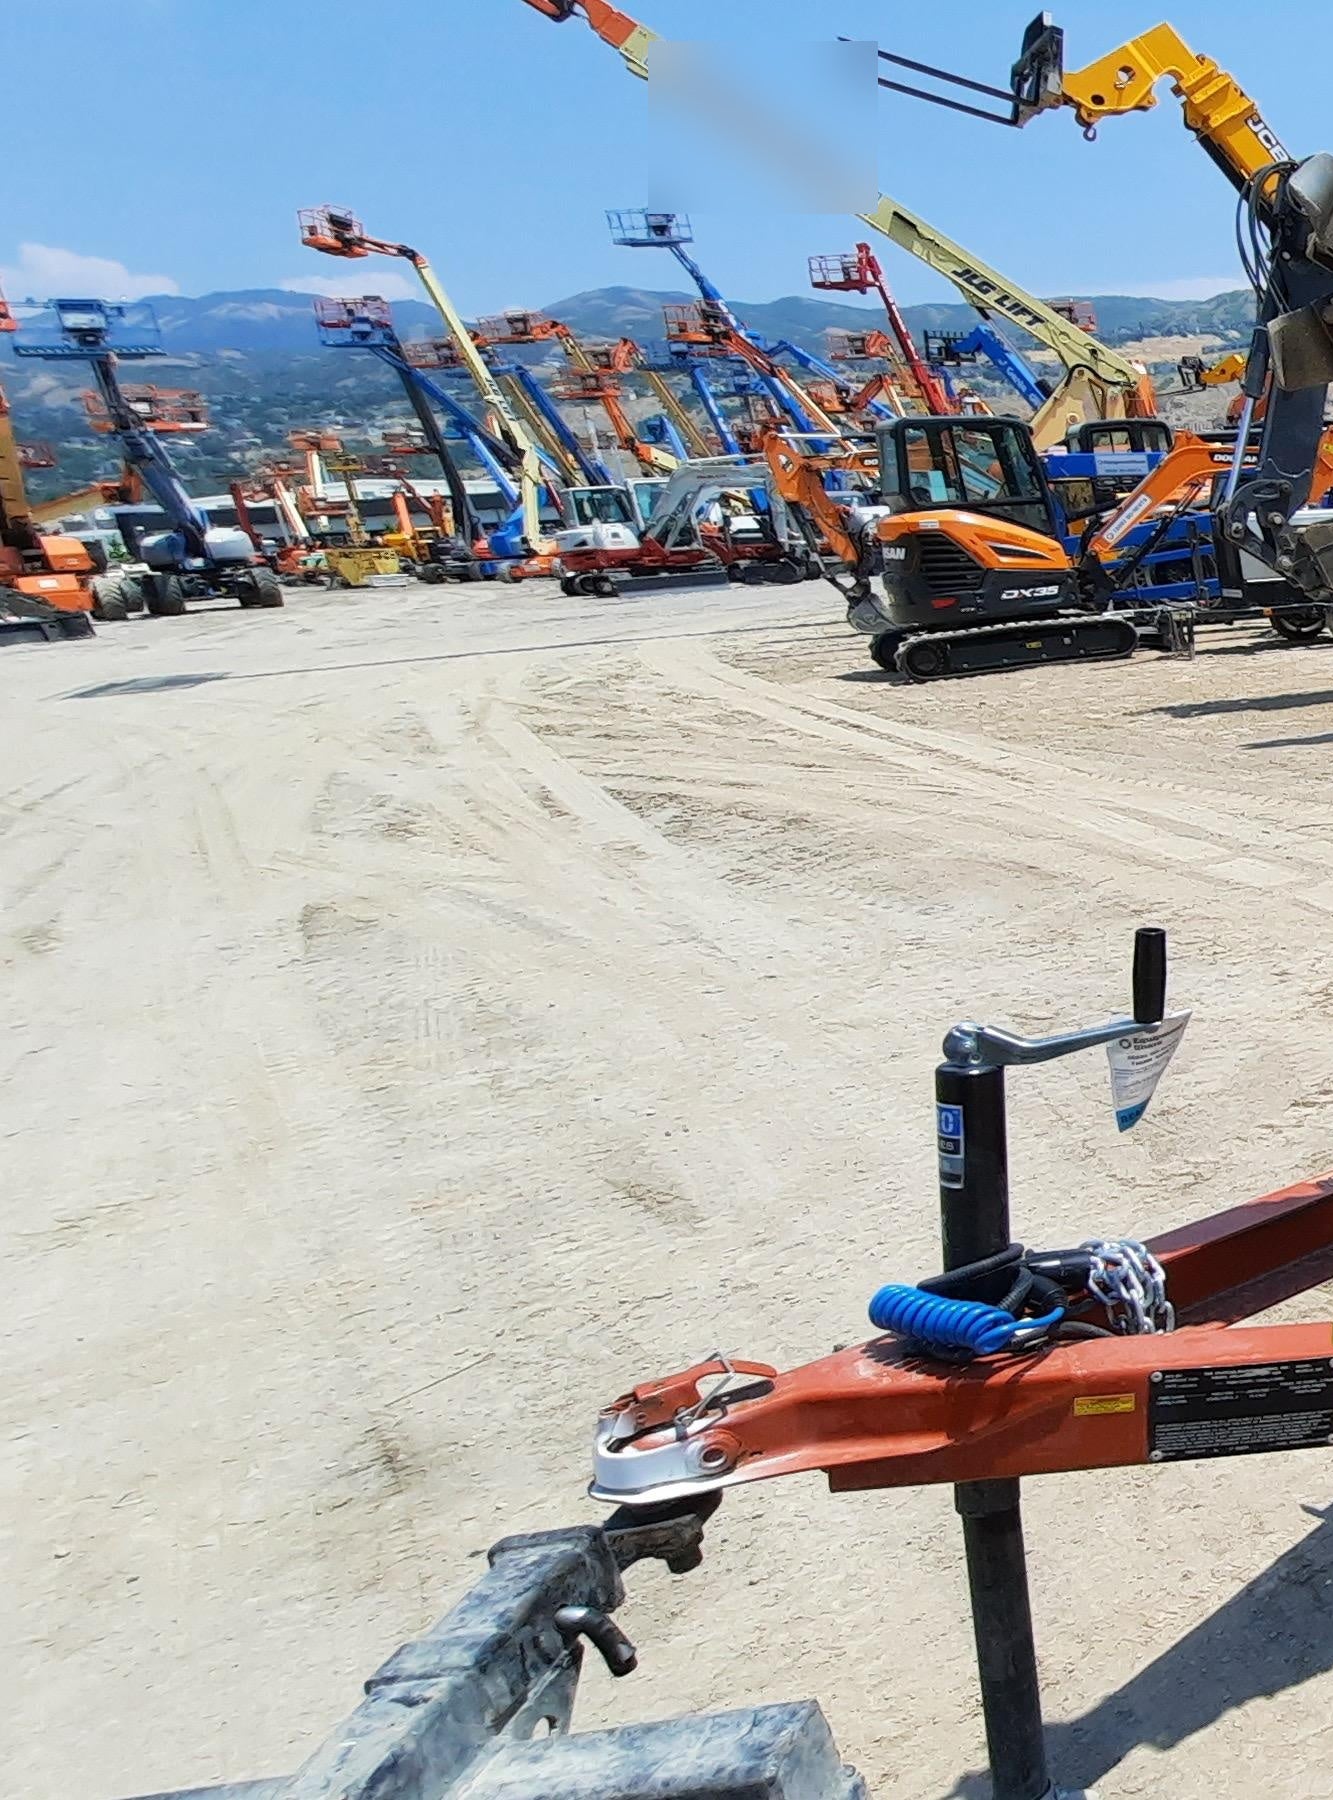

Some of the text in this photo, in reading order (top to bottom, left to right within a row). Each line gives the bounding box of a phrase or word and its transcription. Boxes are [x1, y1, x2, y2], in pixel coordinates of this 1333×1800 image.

[951, 268, 1045, 326] JLG LIFT
[1000, 585, 1060, 600] DX35
